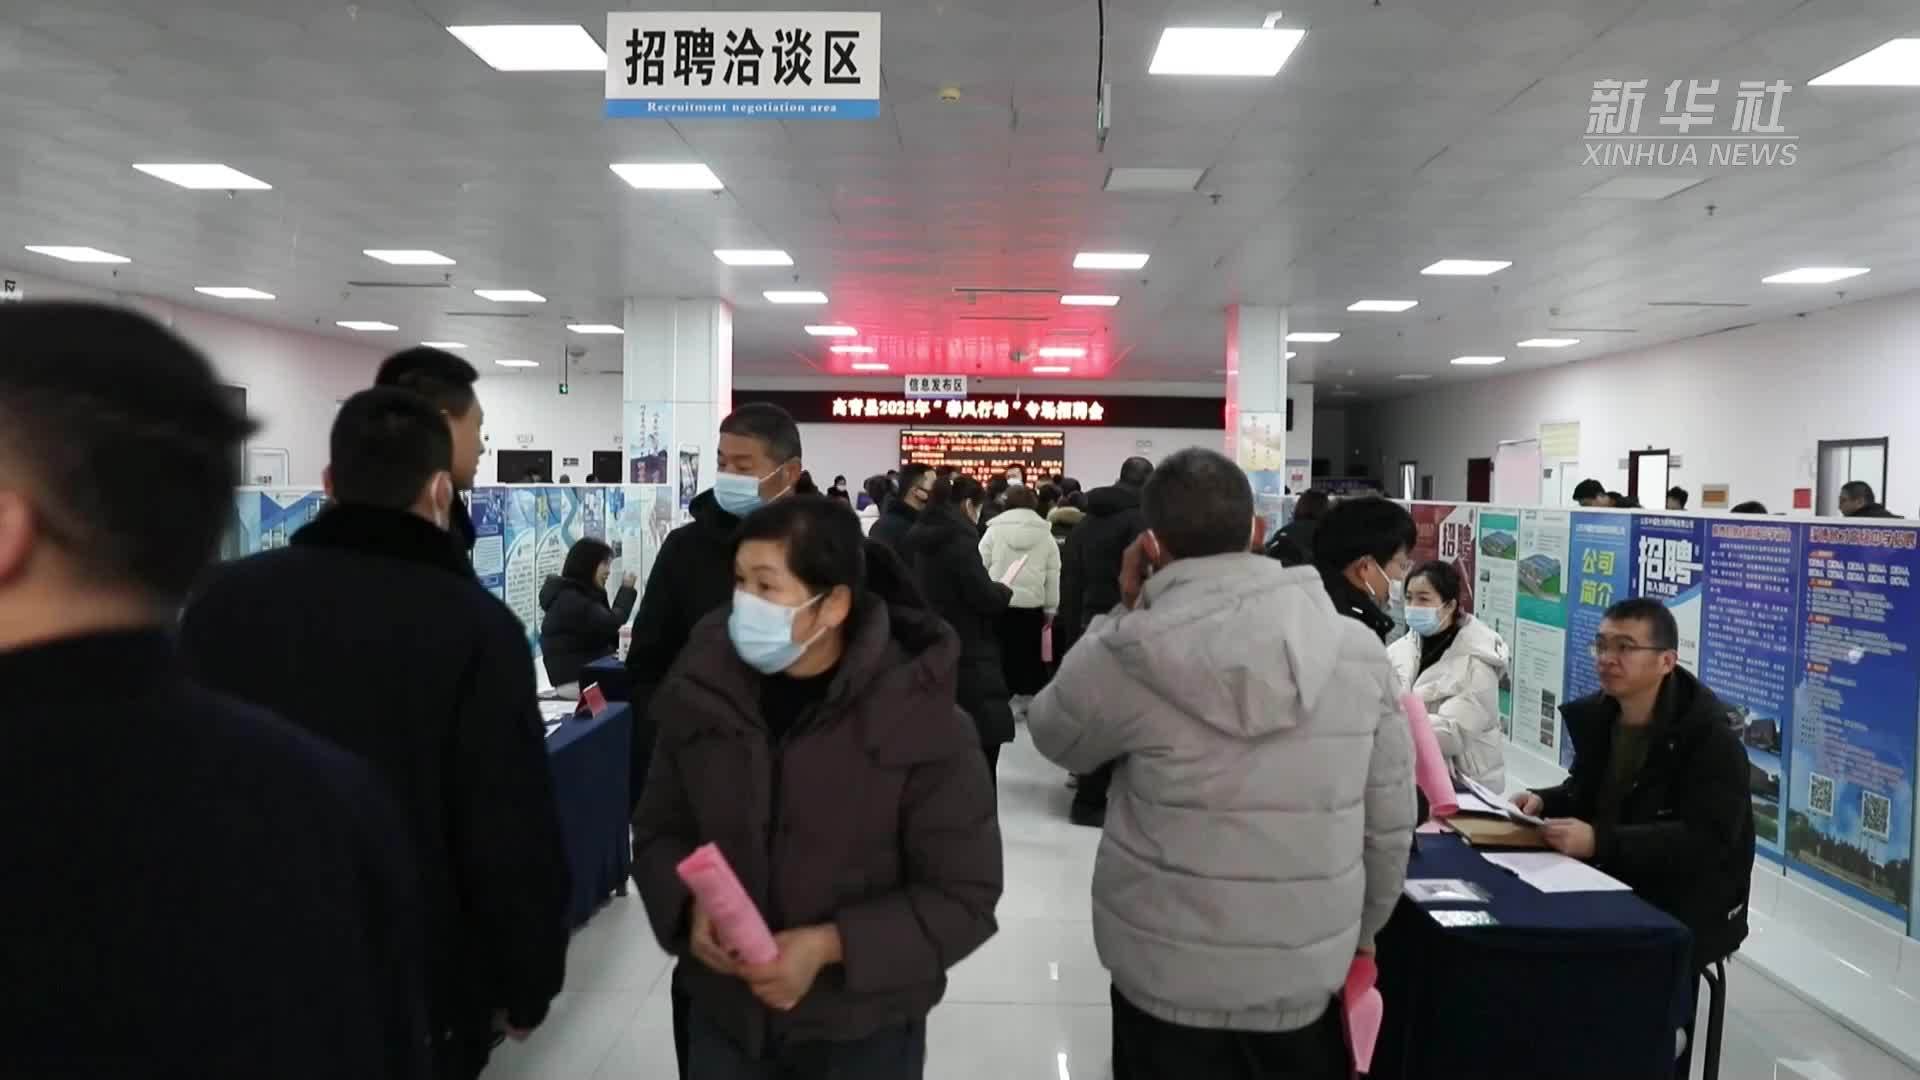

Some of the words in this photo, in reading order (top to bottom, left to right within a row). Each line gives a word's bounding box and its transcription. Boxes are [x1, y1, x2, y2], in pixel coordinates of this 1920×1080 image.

[625, 27, 861, 87] 招聘洽谈区
[647, 102, 726, 113] Recruitment
[732, 102, 805, 115] negotiation
[810, 103, 837, 113] area
[909, 377, 963, 392] 信息发布区
[1442, 522, 1472, 557] 招聘
[1582, 547, 1615, 576] 公司
[1638, 535, 1703, 599] 招聘
[1579, 579, 1614, 608] 简介
